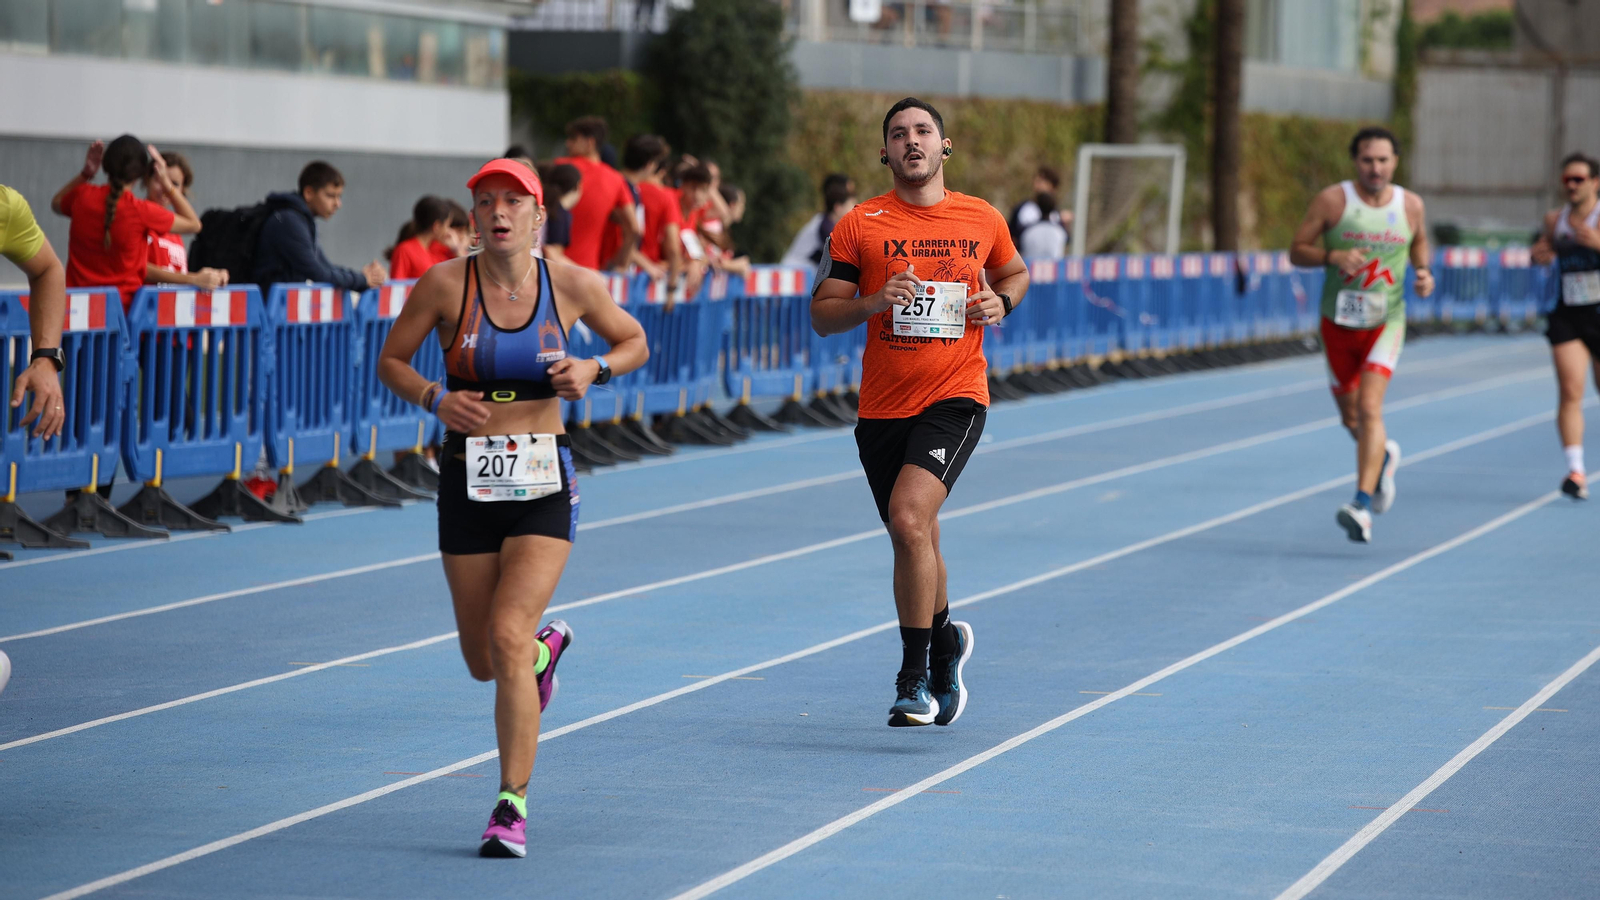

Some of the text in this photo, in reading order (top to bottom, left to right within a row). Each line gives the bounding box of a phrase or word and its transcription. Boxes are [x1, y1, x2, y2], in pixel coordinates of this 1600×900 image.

[883, 239, 909, 258] IX
[911, 239, 956, 248] CARRERA
[911, 248, 951, 258] URBANA
[900, 296, 936, 317] 257
[477, 454, 518, 478] 207
